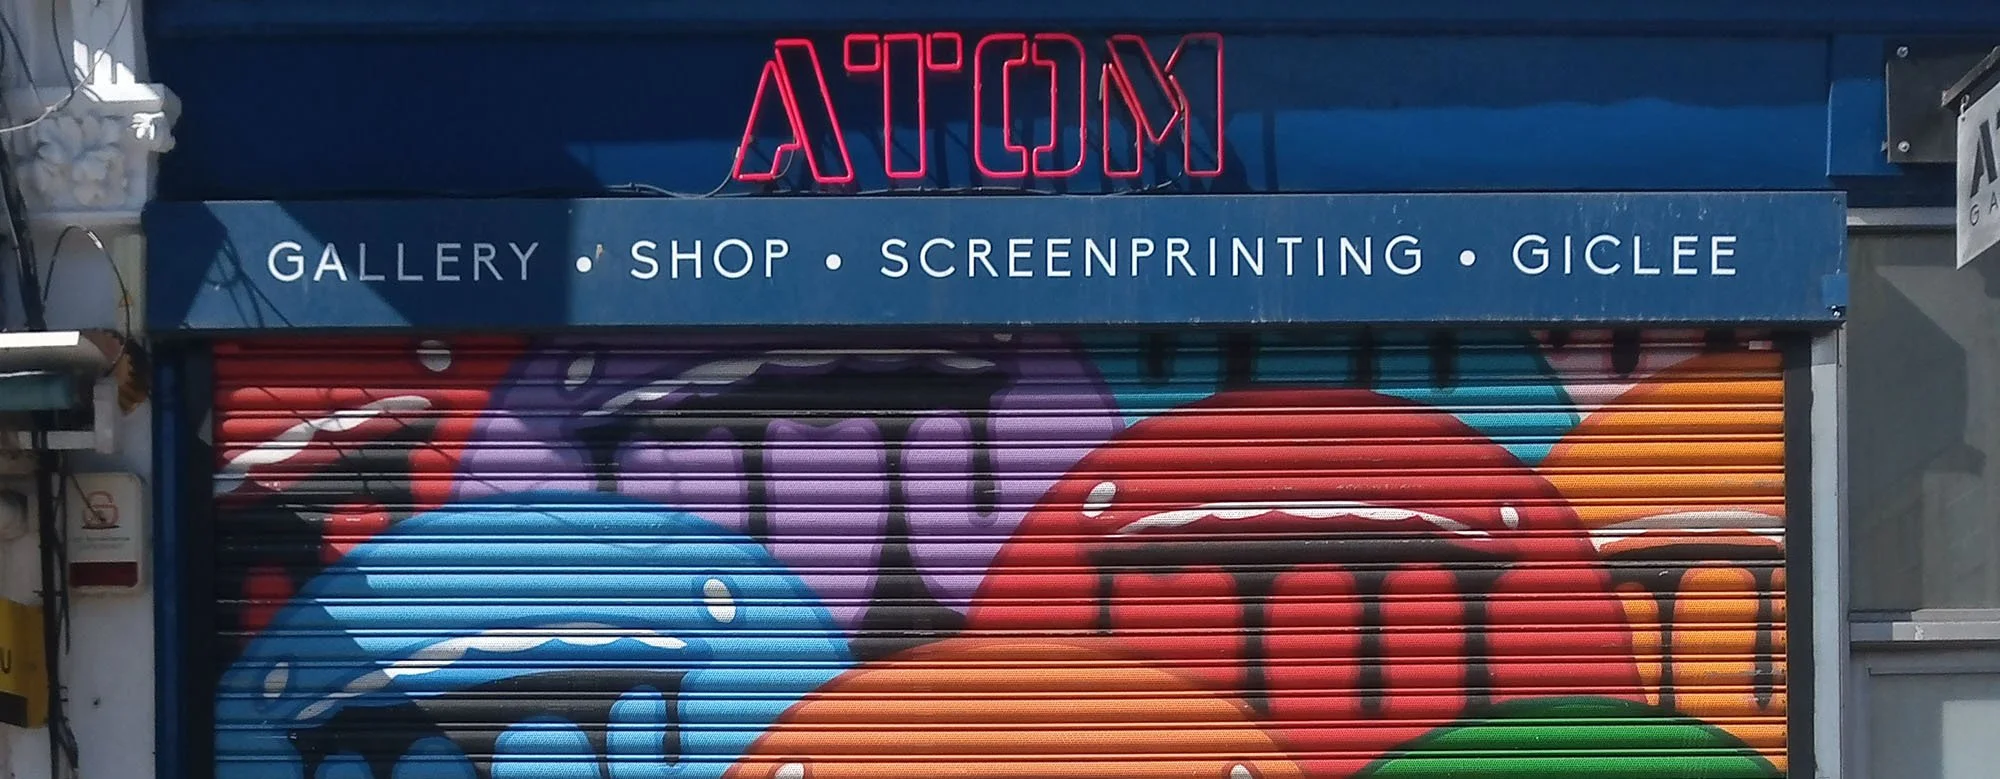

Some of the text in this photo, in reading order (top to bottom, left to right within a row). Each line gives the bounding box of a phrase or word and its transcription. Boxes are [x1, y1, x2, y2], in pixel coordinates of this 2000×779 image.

[733, 32, 1224, 183] ATOM
[267, 234, 1737, 282] GALLERY SHOP SCREENPRINTING GICLEE
